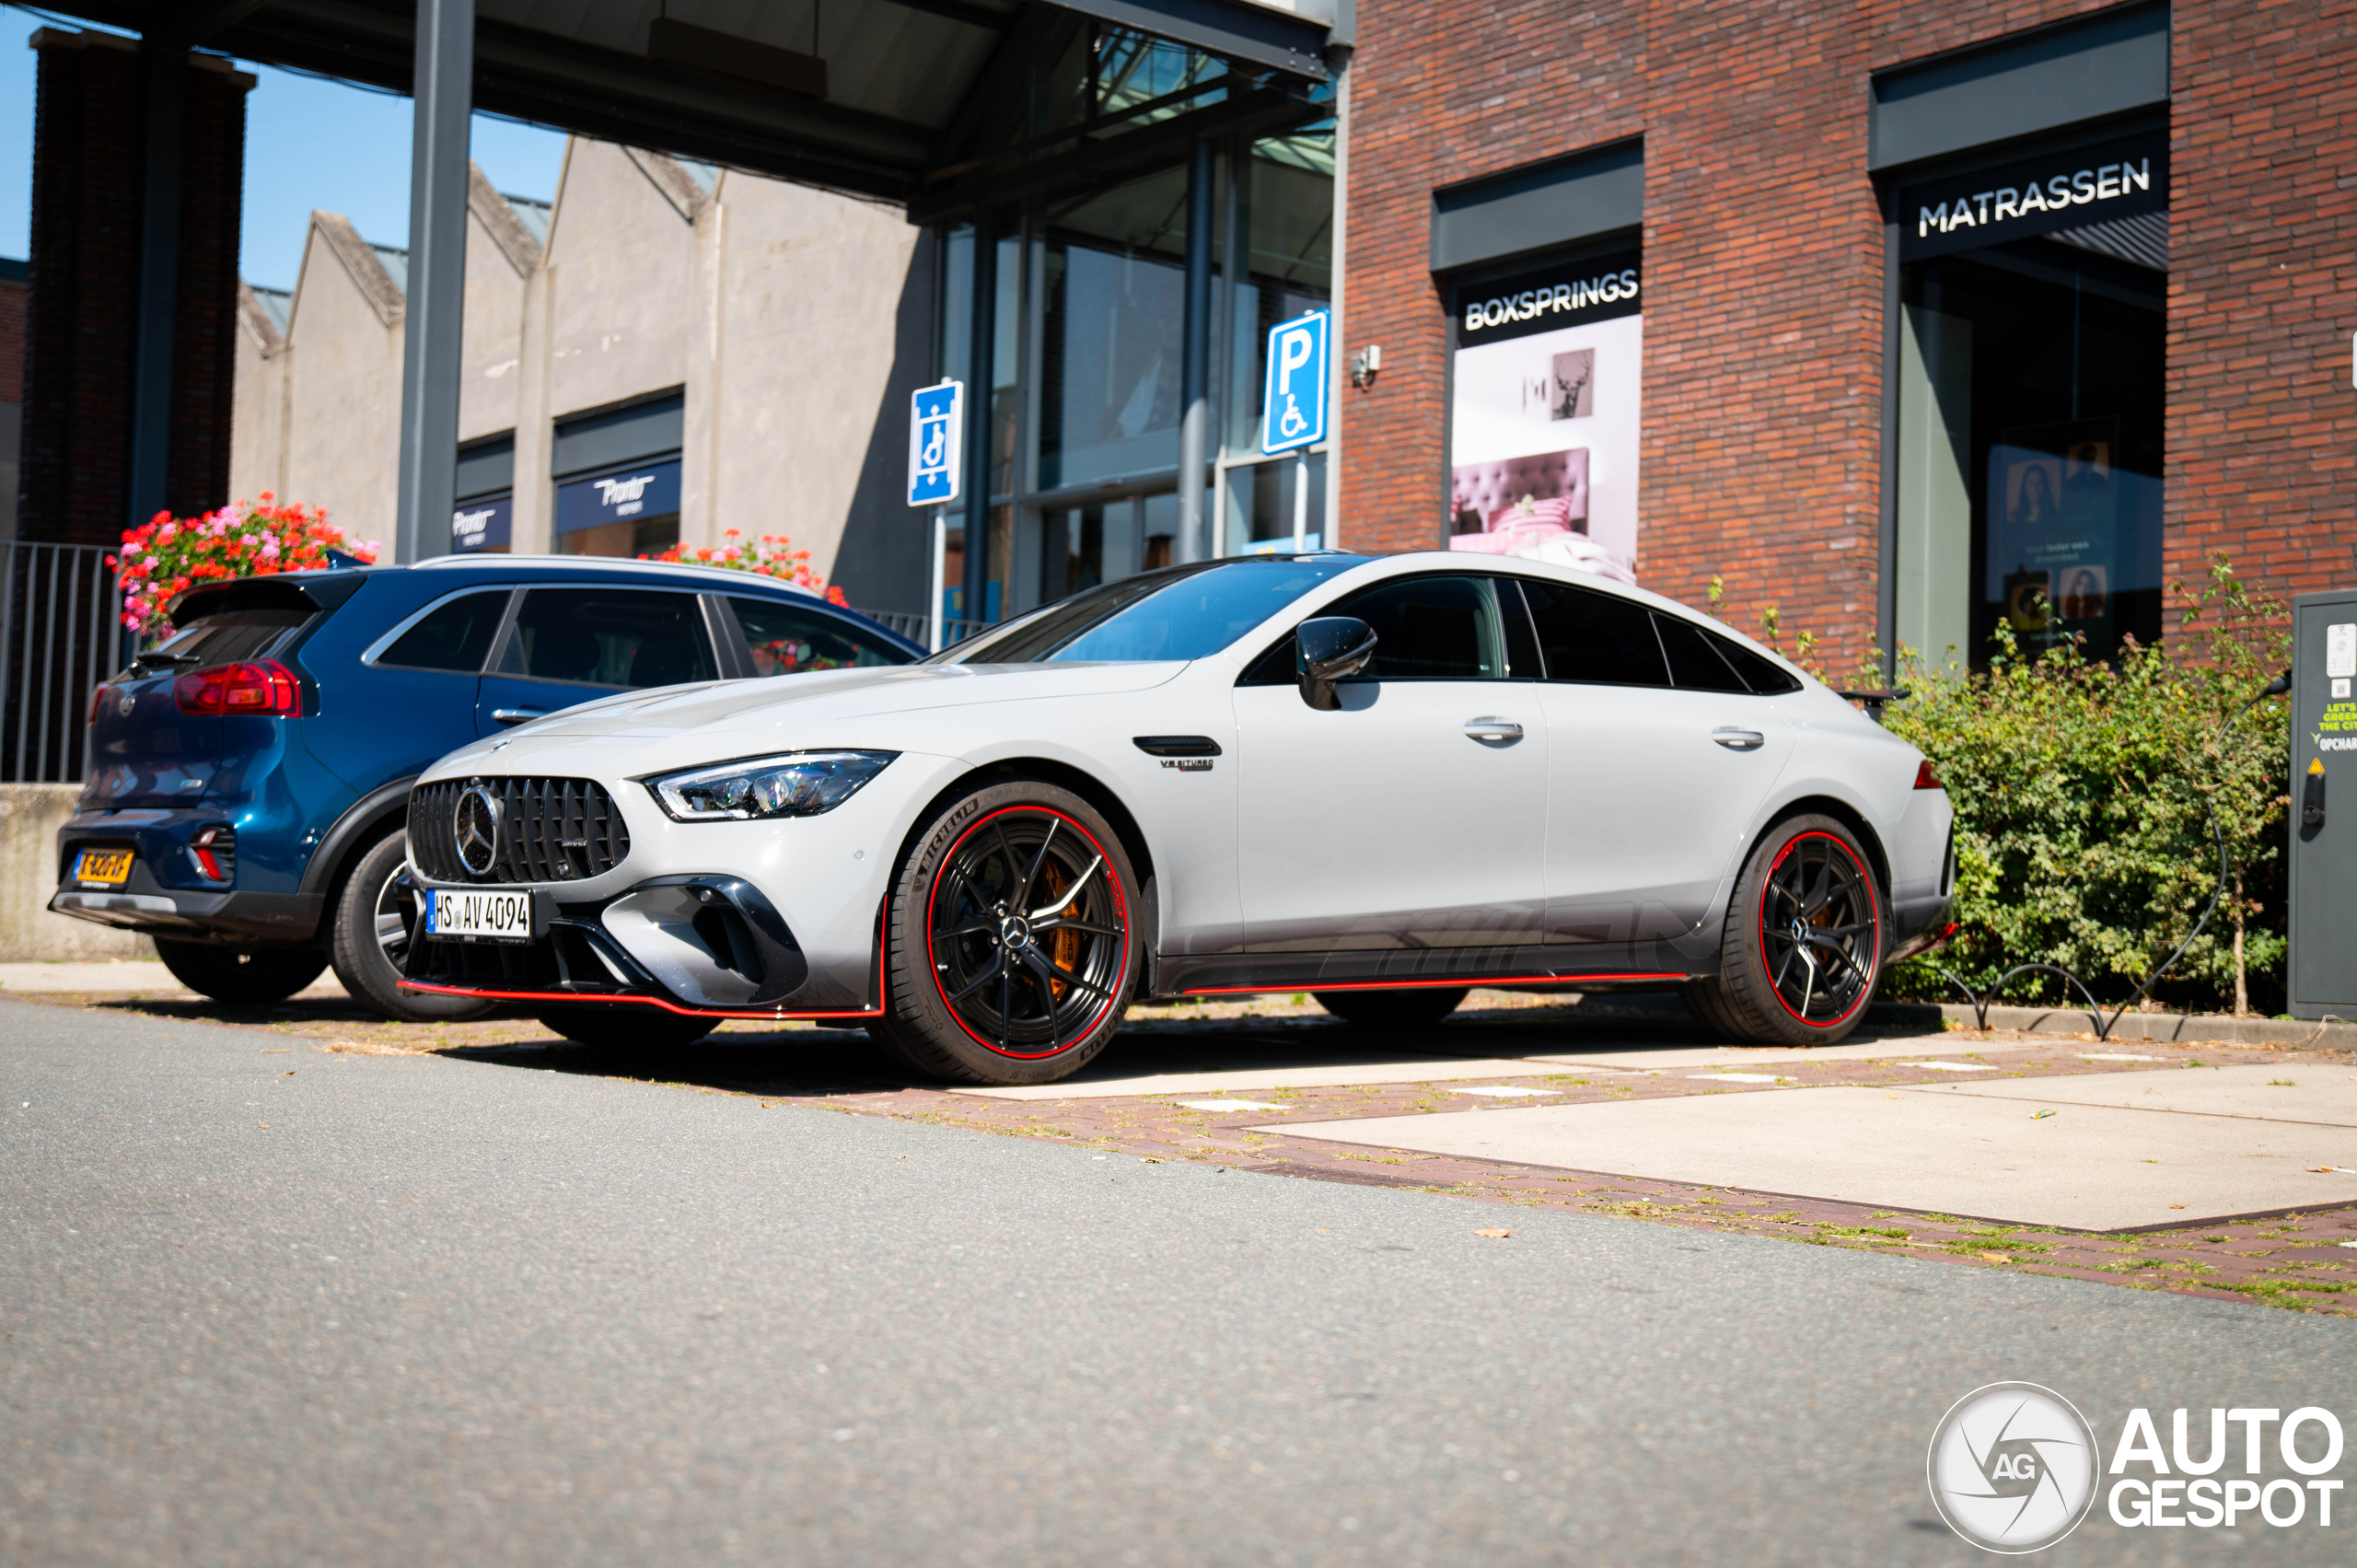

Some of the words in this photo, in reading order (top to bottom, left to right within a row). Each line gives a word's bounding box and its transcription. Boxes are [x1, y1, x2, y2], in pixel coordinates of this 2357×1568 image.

[1919, 157, 2150, 238] MATRASSEN
[1465, 268, 1639, 331] BOXSPRINGS
[1279, 328, 1313, 396] P
[593, 475, 656, 506] Pronto
[2318, 722, 2340, 732] THE
[2327, 703, 2356, 713] LET'S
[921, 799, 977, 870] MICHELIN
[435, 895, 453, 928] HS
[463, 896, 482, 930] AV
[485, 896, 528, 932] 4094
